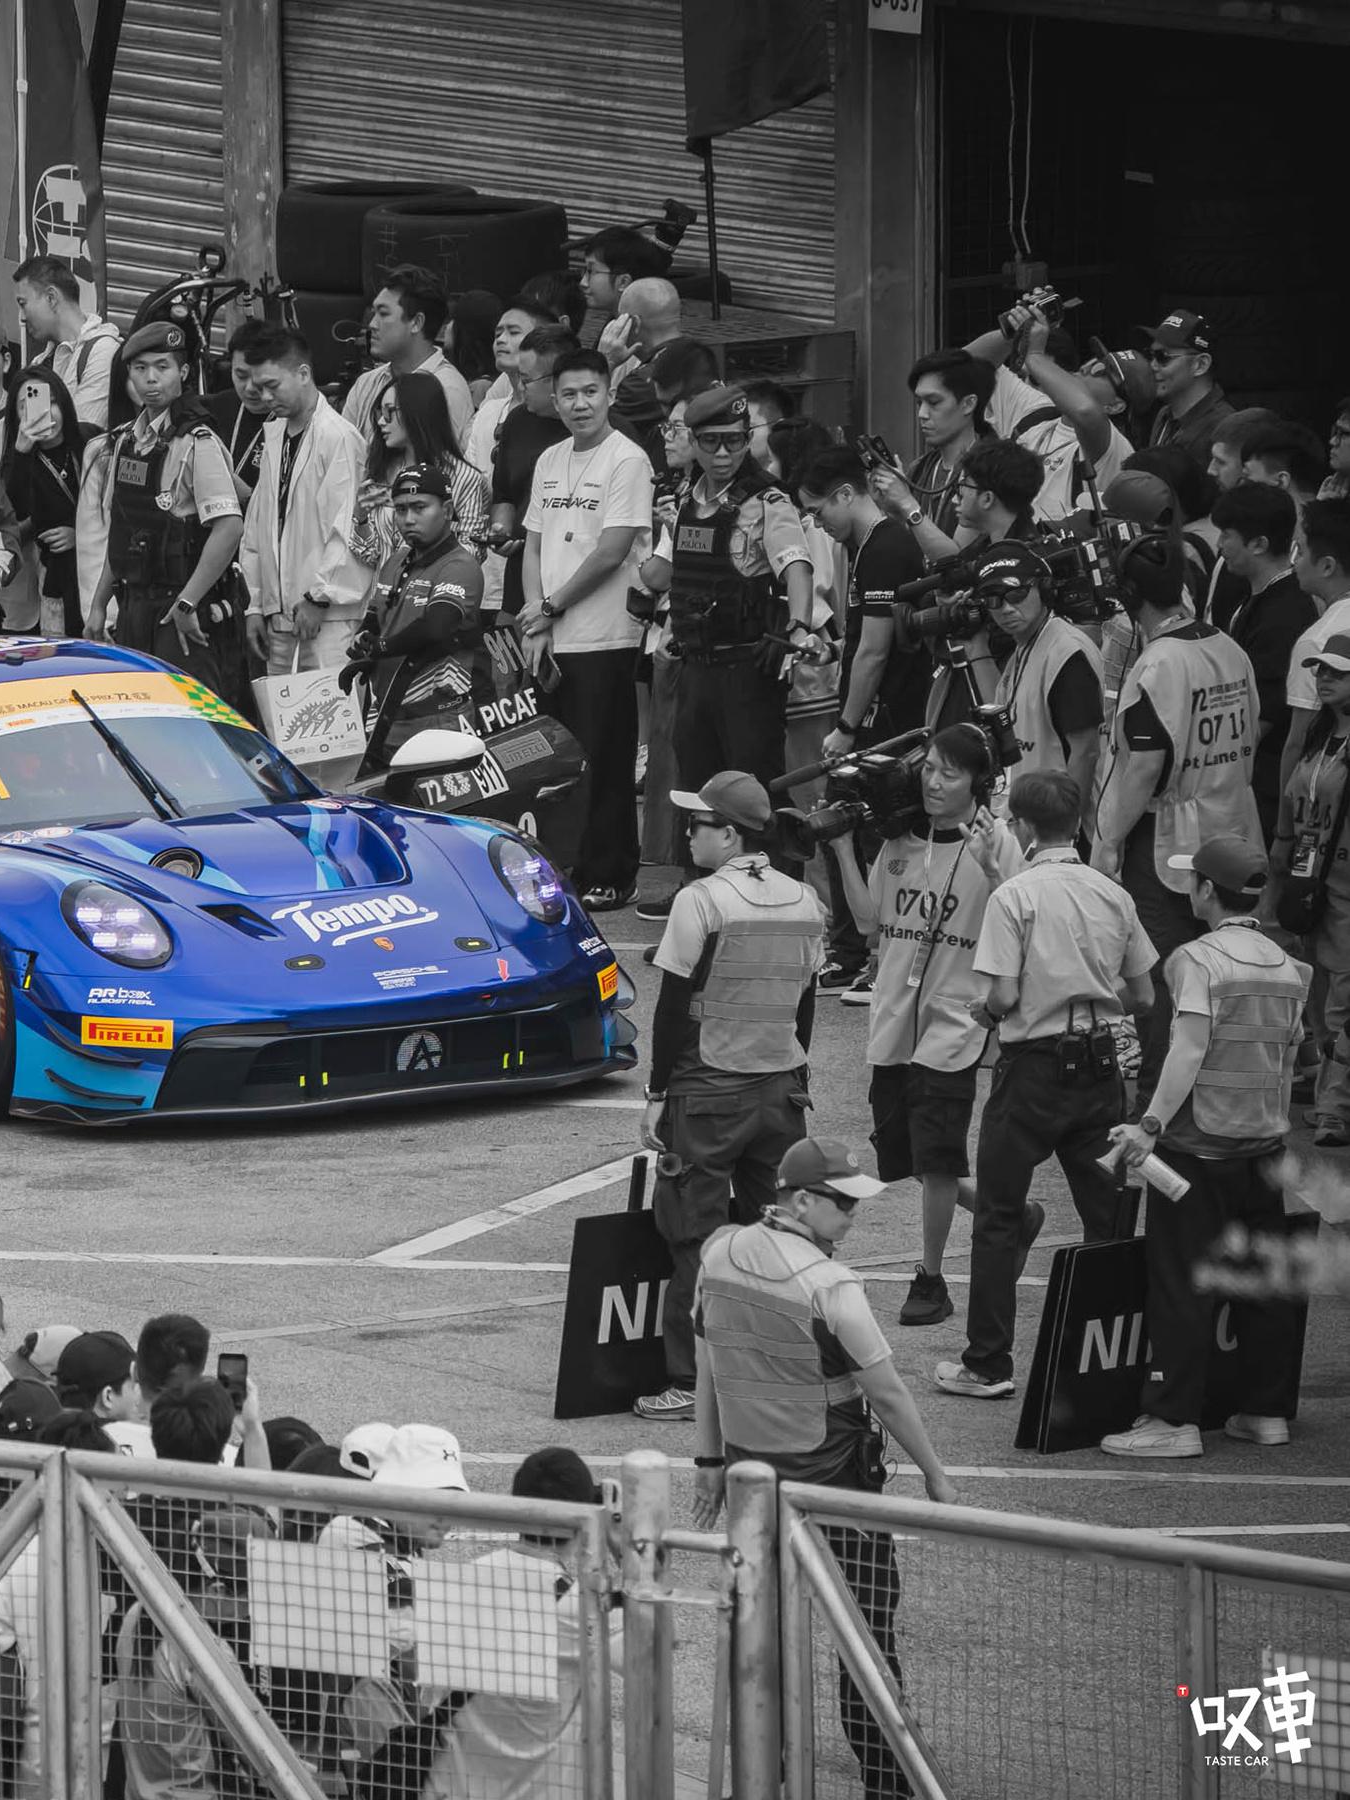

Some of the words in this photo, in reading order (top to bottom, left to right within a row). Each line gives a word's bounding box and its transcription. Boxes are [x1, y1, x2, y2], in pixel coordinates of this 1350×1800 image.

[483, 628, 528, 675] 911
[17, 700, 52, 710] MACAU
[418, 779, 447, 805] 72
[271, 894, 421, 943] Tempo
[88, 987, 117, 998] AR
[88, 1022, 165, 1043] PIRELLI
